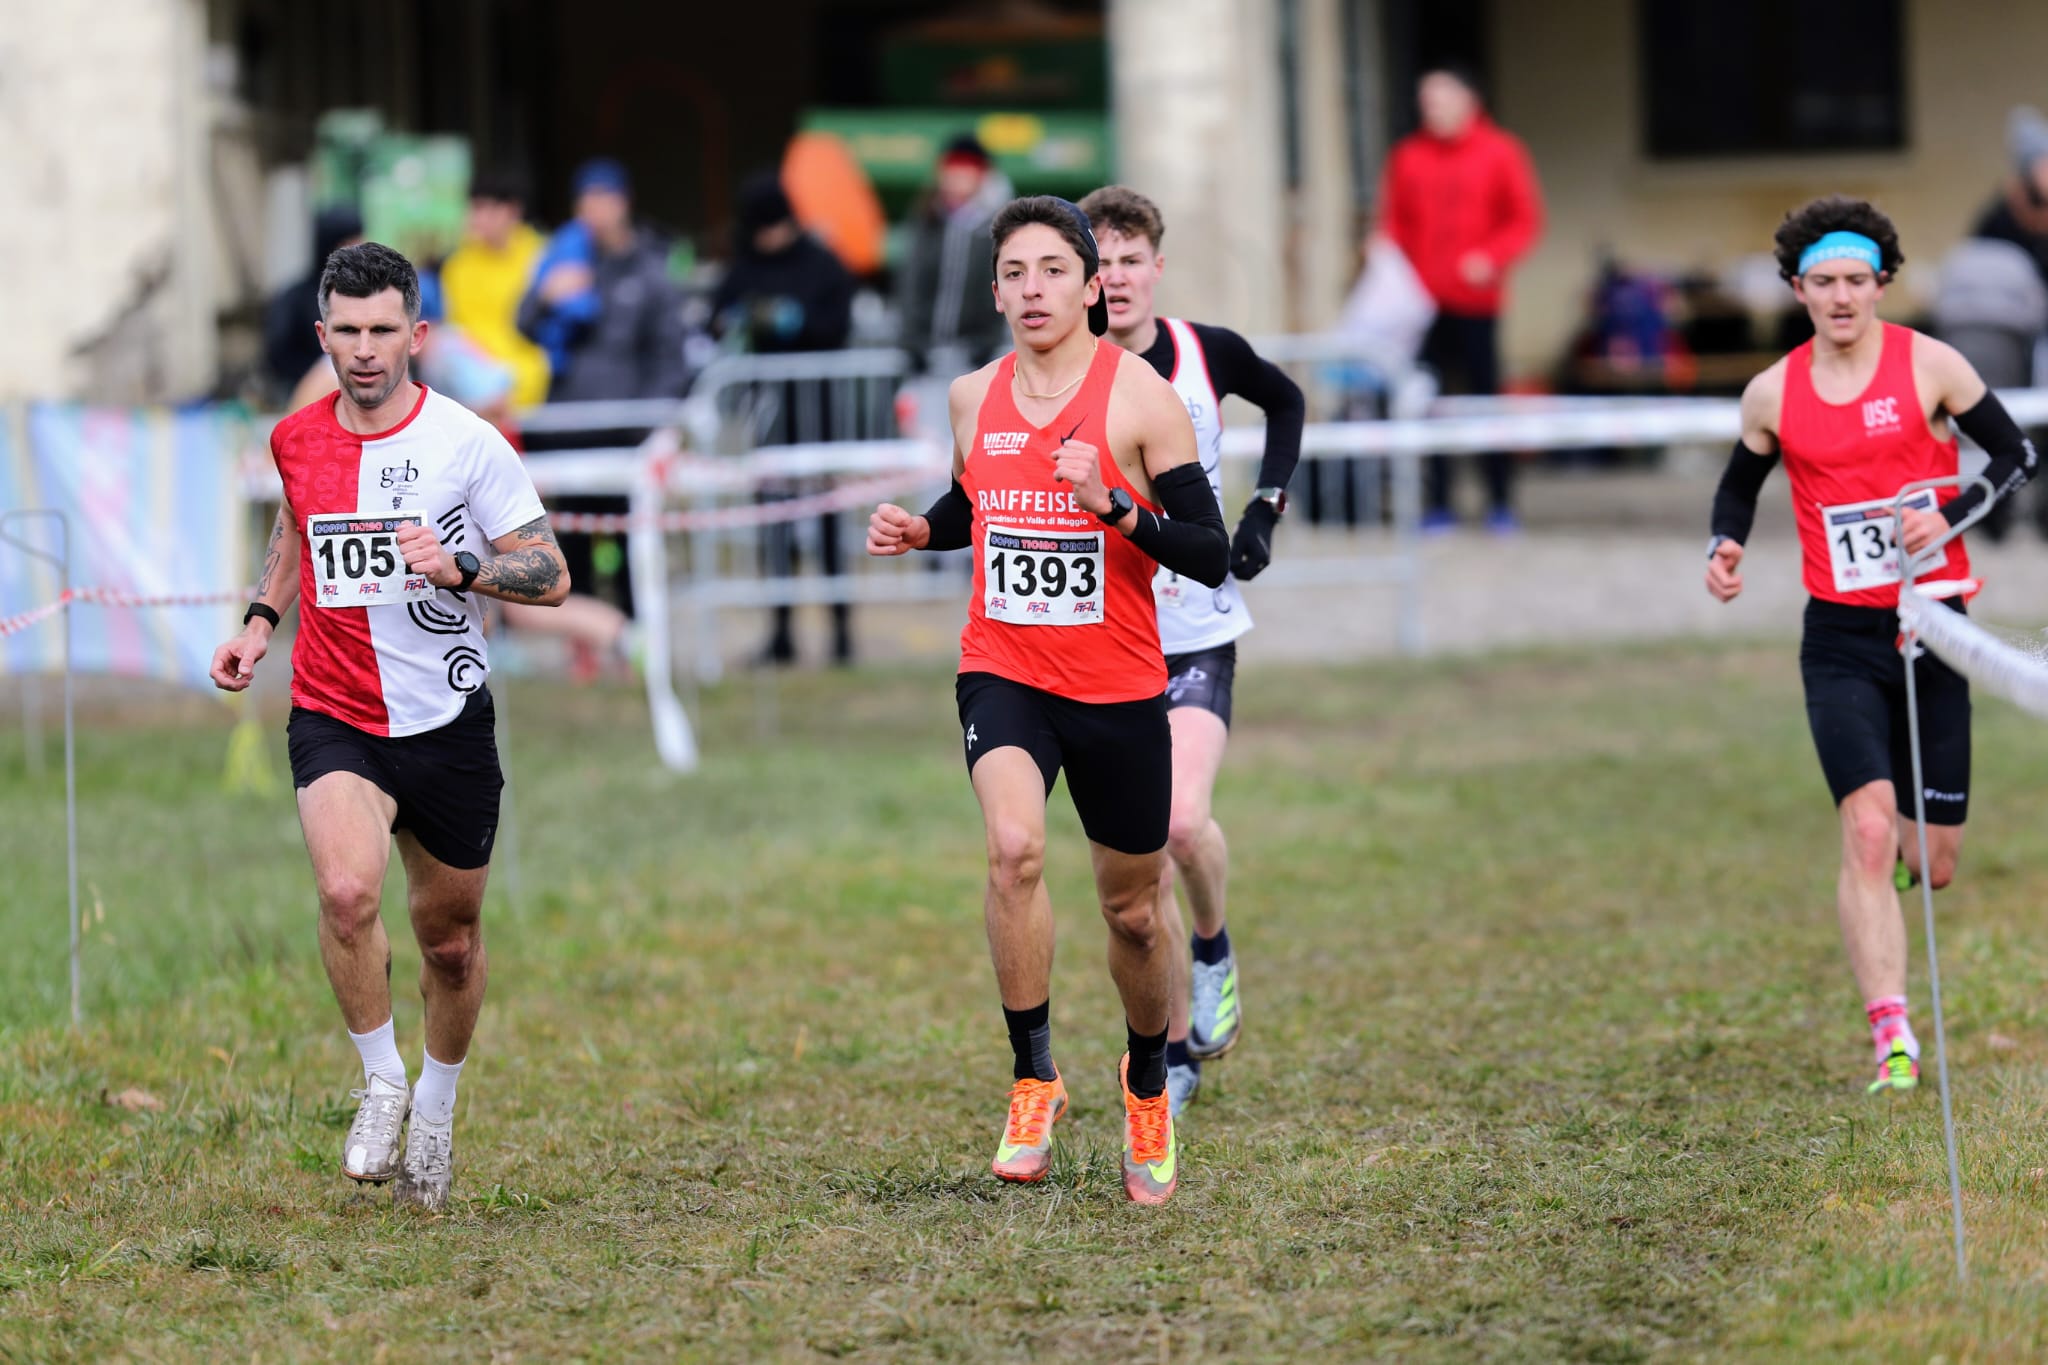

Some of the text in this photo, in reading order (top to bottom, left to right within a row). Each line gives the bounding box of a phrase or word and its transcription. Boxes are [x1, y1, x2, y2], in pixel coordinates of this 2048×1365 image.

[1862, 397, 1899, 427] USC
[983, 432, 1030, 449] VIGOR
[978, 489, 1089, 513] RAIFFEISE
[1026, 517, 1046, 525] Valle
[1047, 517, 1056, 525] di
[1057, 518, 1089, 527] Muggio
[319, 536, 413, 579] 105
[1838, 525, 1899, 563] 13
[992, 551, 1097, 597] 1393
